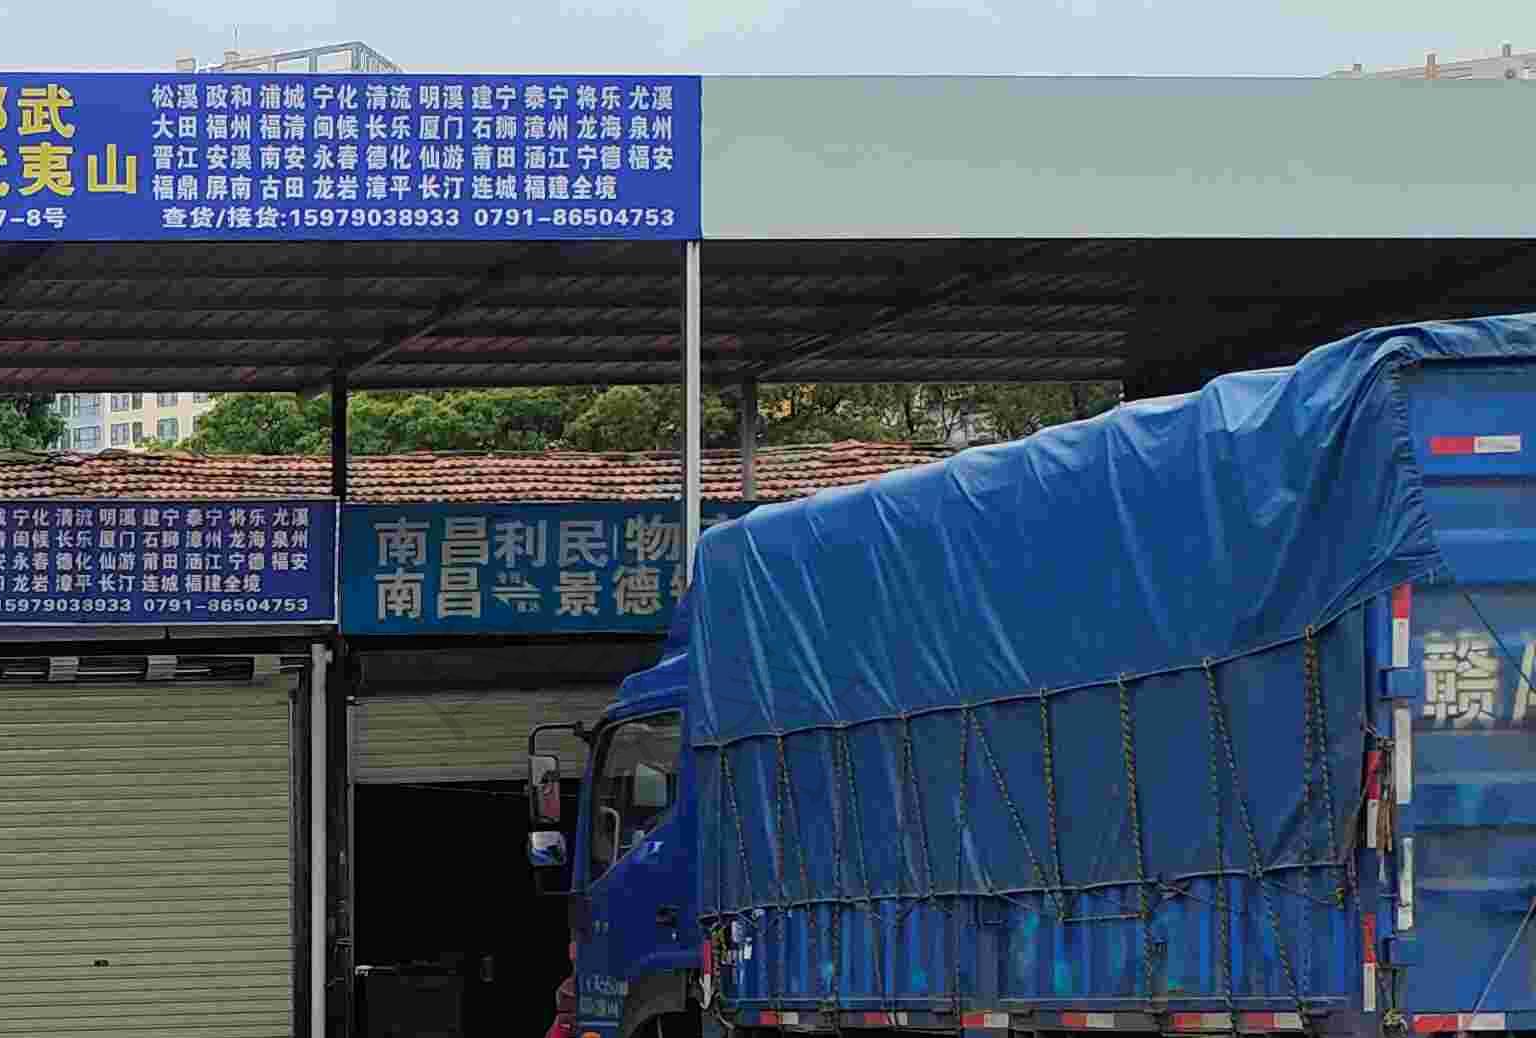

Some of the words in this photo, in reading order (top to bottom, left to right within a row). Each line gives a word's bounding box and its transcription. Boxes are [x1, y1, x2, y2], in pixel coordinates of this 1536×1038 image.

[152, 84, 199, 110] 松溪
[205, 84, 252, 110] 政和
[259, 84, 305, 110] 浦城
[312, 84, 359, 110] 宁化
[365, 84, 412, 110] 清流
[418, 84, 464, 110] 明溪
[471, 84, 517, 110] 建宁
[524, 84, 569, 110] 泰宁
[576, 84, 622, 110] 将乐
[628, 84, 673, 110] 尤溪
[152, 114, 199, 140] 大田
[205, 114, 252, 140] 福州
[259, 114, 305, 140] 福清
[365, 114, 412, 140] 长乐
[418, 114, 464, 140] 厦门
[471, 114, 517, 140] 石狮
[524, 114, 569, 140] 漳州
[576, 114, 622, 140] 龙海
[628, 114, 673, 140] 泉州
[152, 145, 199, 170] 晋江
[205, 145, 252, 170] 安溪
[259, 145, 305, 170] 南安
[312, 145, 359, 170] 永春
[365, 145, 412, 170] 德化
[418, 145, 464, 170] 仙游
[471, 145, 517, 170] 莆田
[524, 145, 569, 170] 涵江
[576, 145, 622, 170] 宁德
[628, 145, 673, 170] 福安
[152, 175, 199, 200] 福鼎
[205, 175, 252, 200] 屏南
[259, 175, 305, 200] 古田
[312, 175, 359, 200] 龙岩
[365, 175, 412, 200] 漳平
[418, 175, 464, 200] 长汀
[471, 175, 517, 200] 连城
[524, 175, 617, 200] 福建全境
[473, 207, 675, 227] 0791-86504753
[143, 597, 310, 613] 0791-86504753
[374, 567, 484, 622] 南昌
